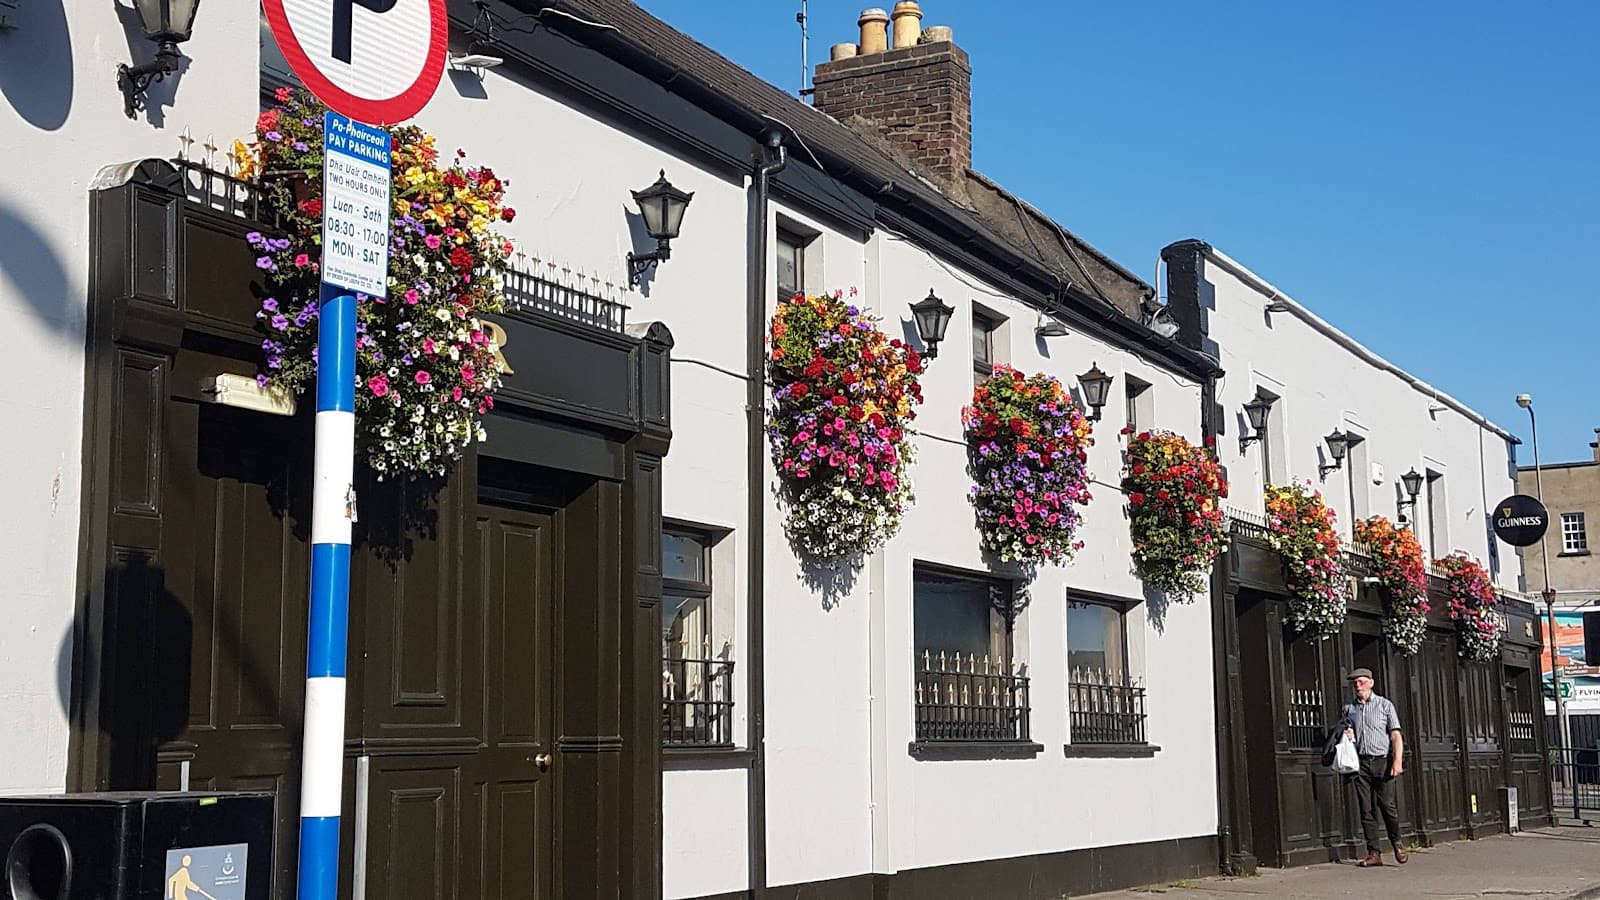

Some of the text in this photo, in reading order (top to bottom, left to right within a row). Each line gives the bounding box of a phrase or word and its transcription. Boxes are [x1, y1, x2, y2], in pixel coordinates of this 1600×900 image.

[328, 133, 387, 163] PAY PARKING
[329, 172, 387, 199] TWO HOURS ONLY
[333, 195, 354, 214] Luan
[362, 205, 382, 224] Sath
[327, 217, 355, 237] 08:30
[363, 227, 386, 246] 17:00
[332, 239, 354, 258] MON
[362, 248, 380, 266] SAT
[1498, 516, 1542, 528] GUINNESS
